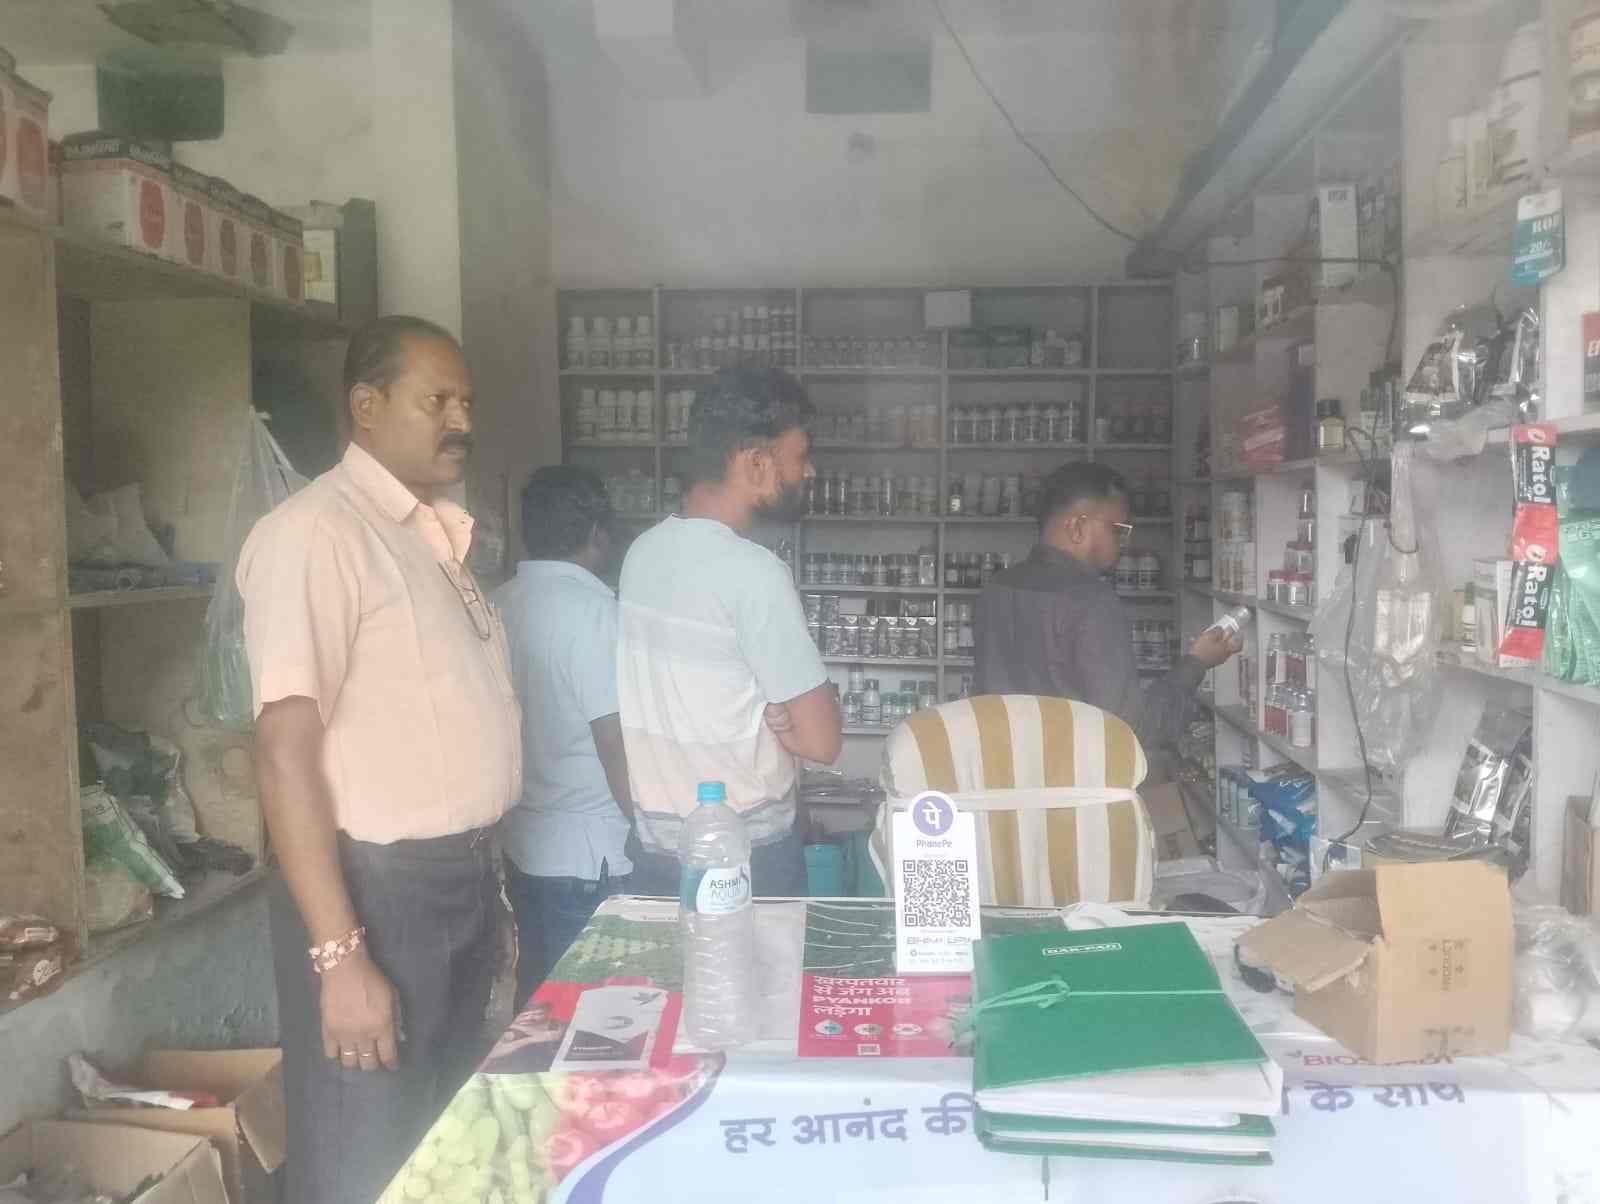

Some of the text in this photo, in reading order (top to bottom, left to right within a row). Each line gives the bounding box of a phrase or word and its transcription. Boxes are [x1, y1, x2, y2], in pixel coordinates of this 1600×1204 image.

[1531, 446, 1551, 504] Ratol
[1520, 565, 1548, 627] Ratol
[916, 839, 953, 849] PhonePe
[1303, 1079, 1355, 1112] के
[720, 1117, 776, 1153] हर
[792, 1097, 908, 1145] आनंद
